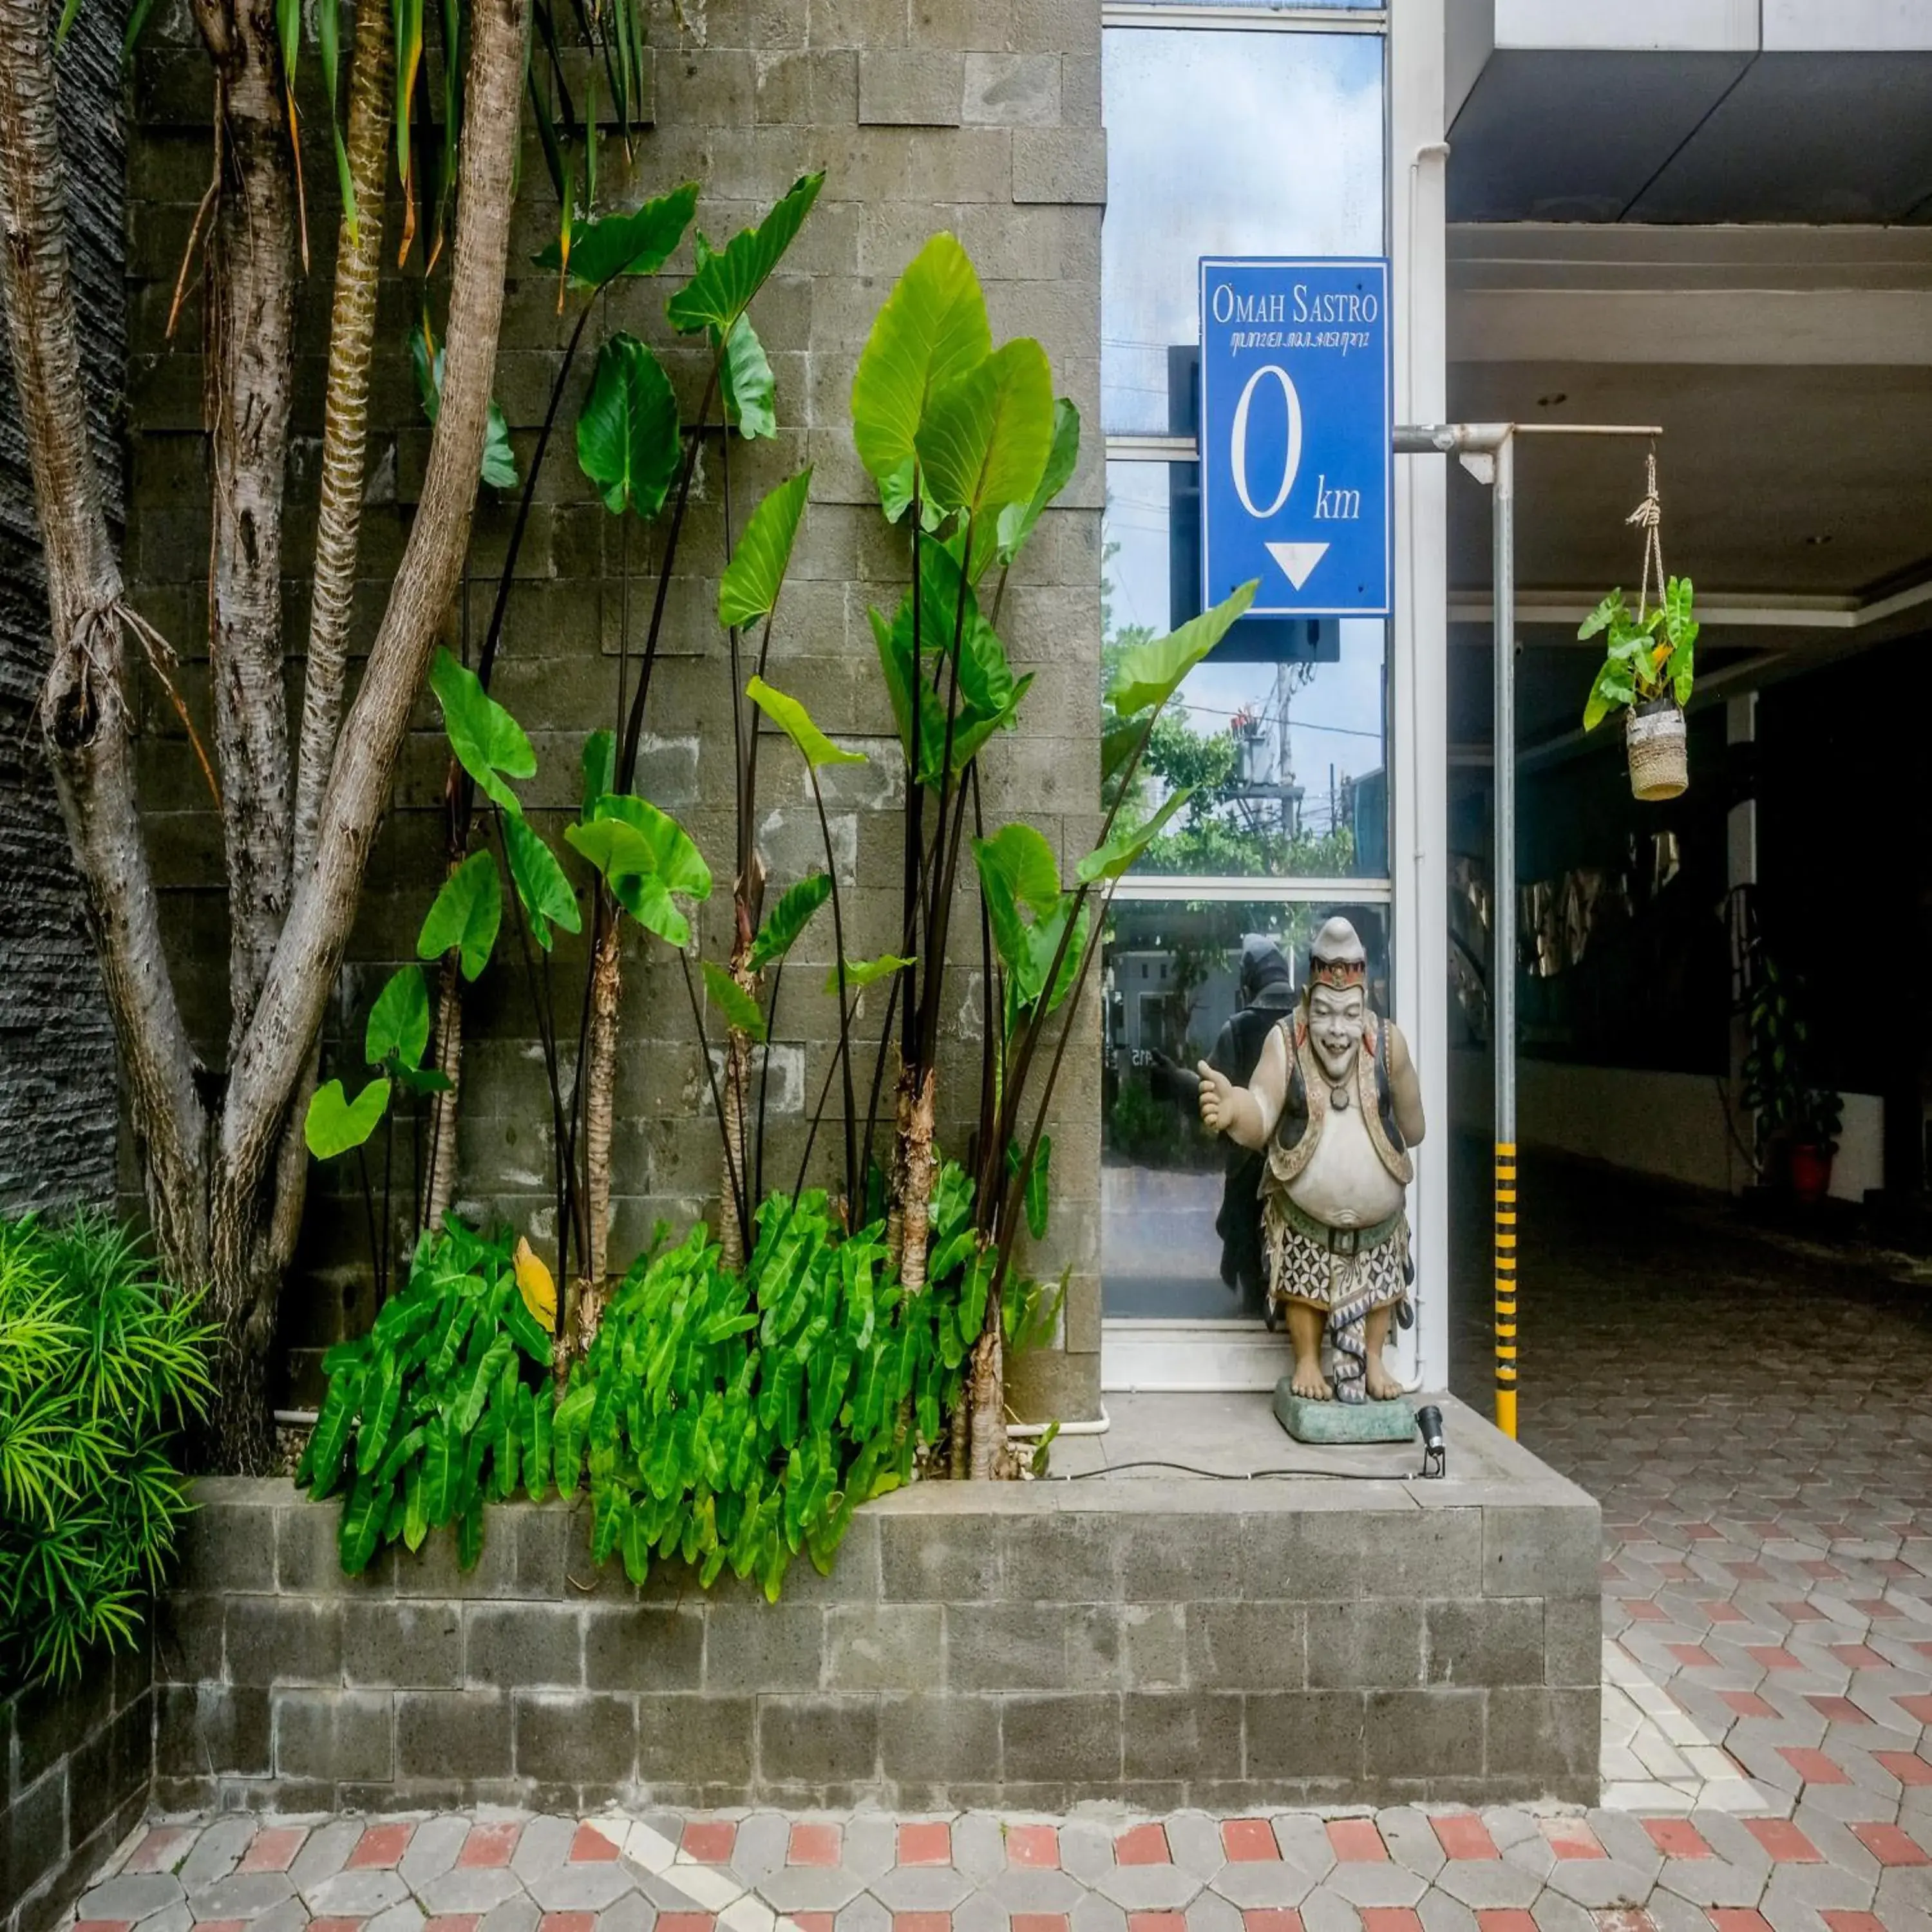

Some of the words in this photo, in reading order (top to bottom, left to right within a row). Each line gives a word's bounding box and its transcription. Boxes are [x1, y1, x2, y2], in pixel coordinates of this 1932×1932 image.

[1213, 283, 1285, 323] OMAH
[1293, 284, 1378, 323] SASTRO
[1231, 365, 1302, 518] 0
[1314, 474, 1359, 519] km
